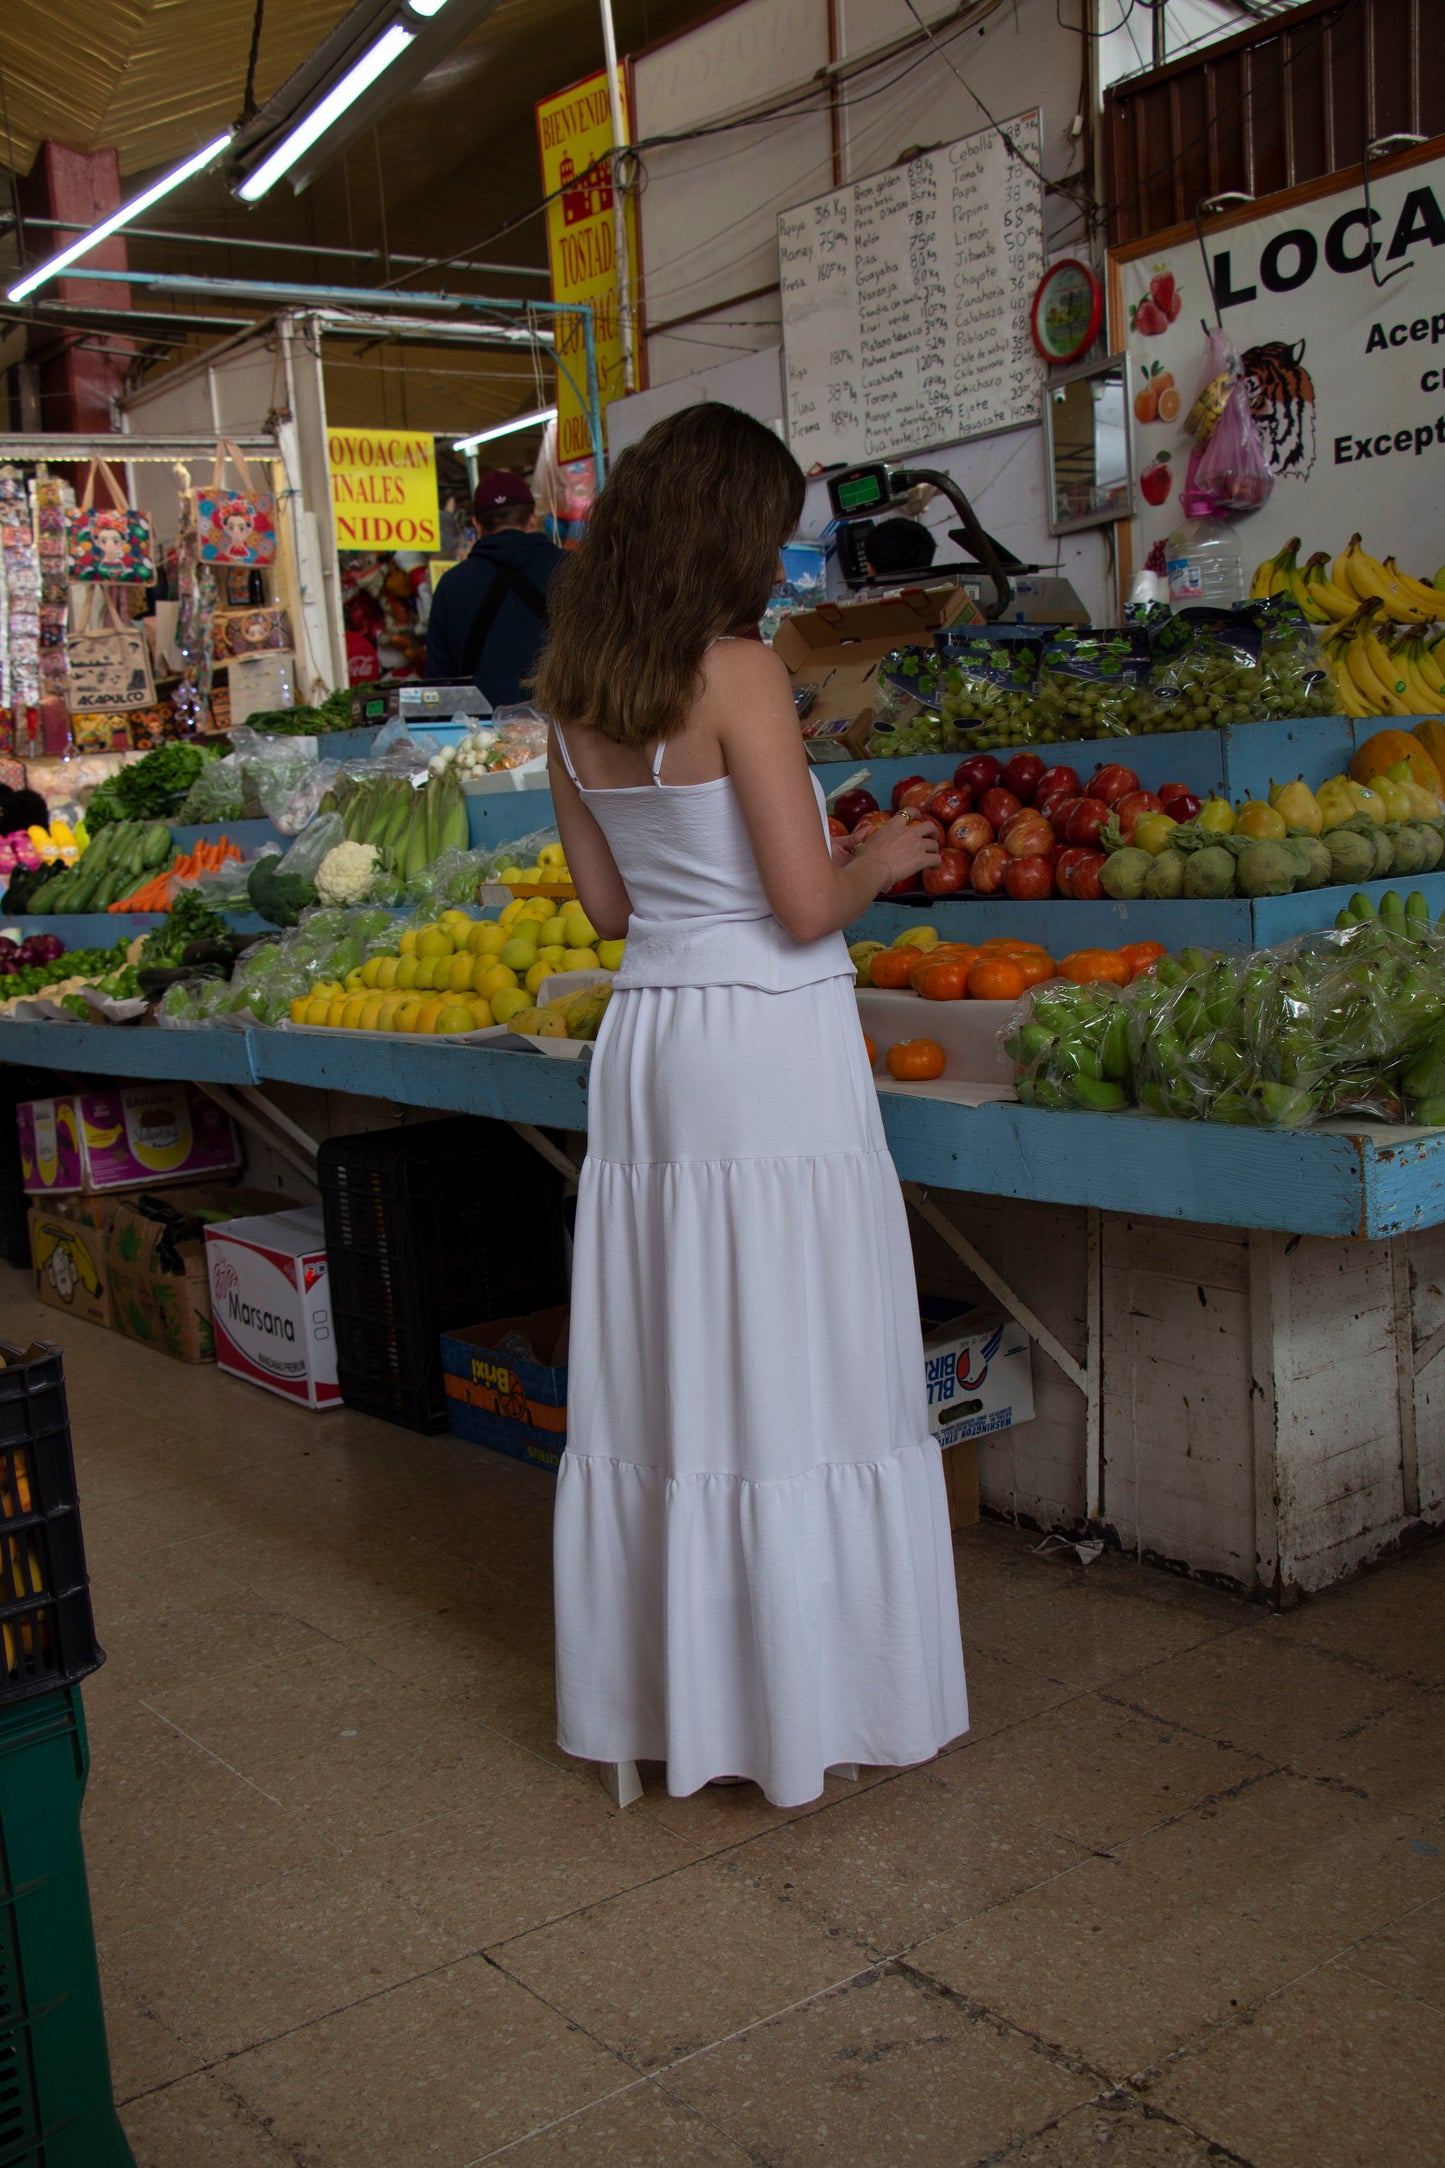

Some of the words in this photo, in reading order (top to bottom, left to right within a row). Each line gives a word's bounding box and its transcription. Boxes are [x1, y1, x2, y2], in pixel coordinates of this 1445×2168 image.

[948, 135, 994, 165] Cebolla
[951, 161, 985, 184] Tomate
[952, 184, 978, 201] Papa
[952, 203, 990, 224] Pepino
[1005, 184, 1021, 203] 38
[780, 217, 806, 240] Papaya
[815, 202, 832, 225] 36
[854, 203, 874, 217] Pera
[854, 218, 874, 231] Pera
[954, 221, 989, 247] Limón
[780, 245, 814, 265] Mamey
[956, 243, 997, 268] Jitomate
[1003, 231, 1027, 252] 50
[1213, 184, 1445, 310] LOCA
[782, 276, 807, 294] Fresa
[855, 261, 899, 286] Guayaba
[953, 268, 998, 291] Chayote
[858, 283, 898, 304] Naranja
[955, 285, 1006, 312] Zanahoria
[1009, 274, 1026, 293] 36
[954, 307, 1004, 329] Calabaza
[1010, 297, 1027, 310] 40
[957, 327, 998, 350] Poblano
[954, 349, 975, 368] Chile
[953, 374, 1003, 398] Chicharo
[791, 390, 817, 416] Tuna
[958, 399, 989, 421] Ejote
[958, 408, 1006, 435] Aguacate
[329, 435, 431, 469] OYOACAN
[863, 440, 888, 456] Uva
[332, 473, 406, 505] INALES
[336, 516, 436, 543] NIDOS
[78, 690, 145, 706] ACAPULCO
[228, 1290, 295, 1343] Marsana
[471, 1357, 510, 1395] Brixi
[926, 1353, 956, 1381] BIR
[961, 1416, 1012, 1438] WASHINGTON
[527, 1445, 560, 1466] CITRUS
